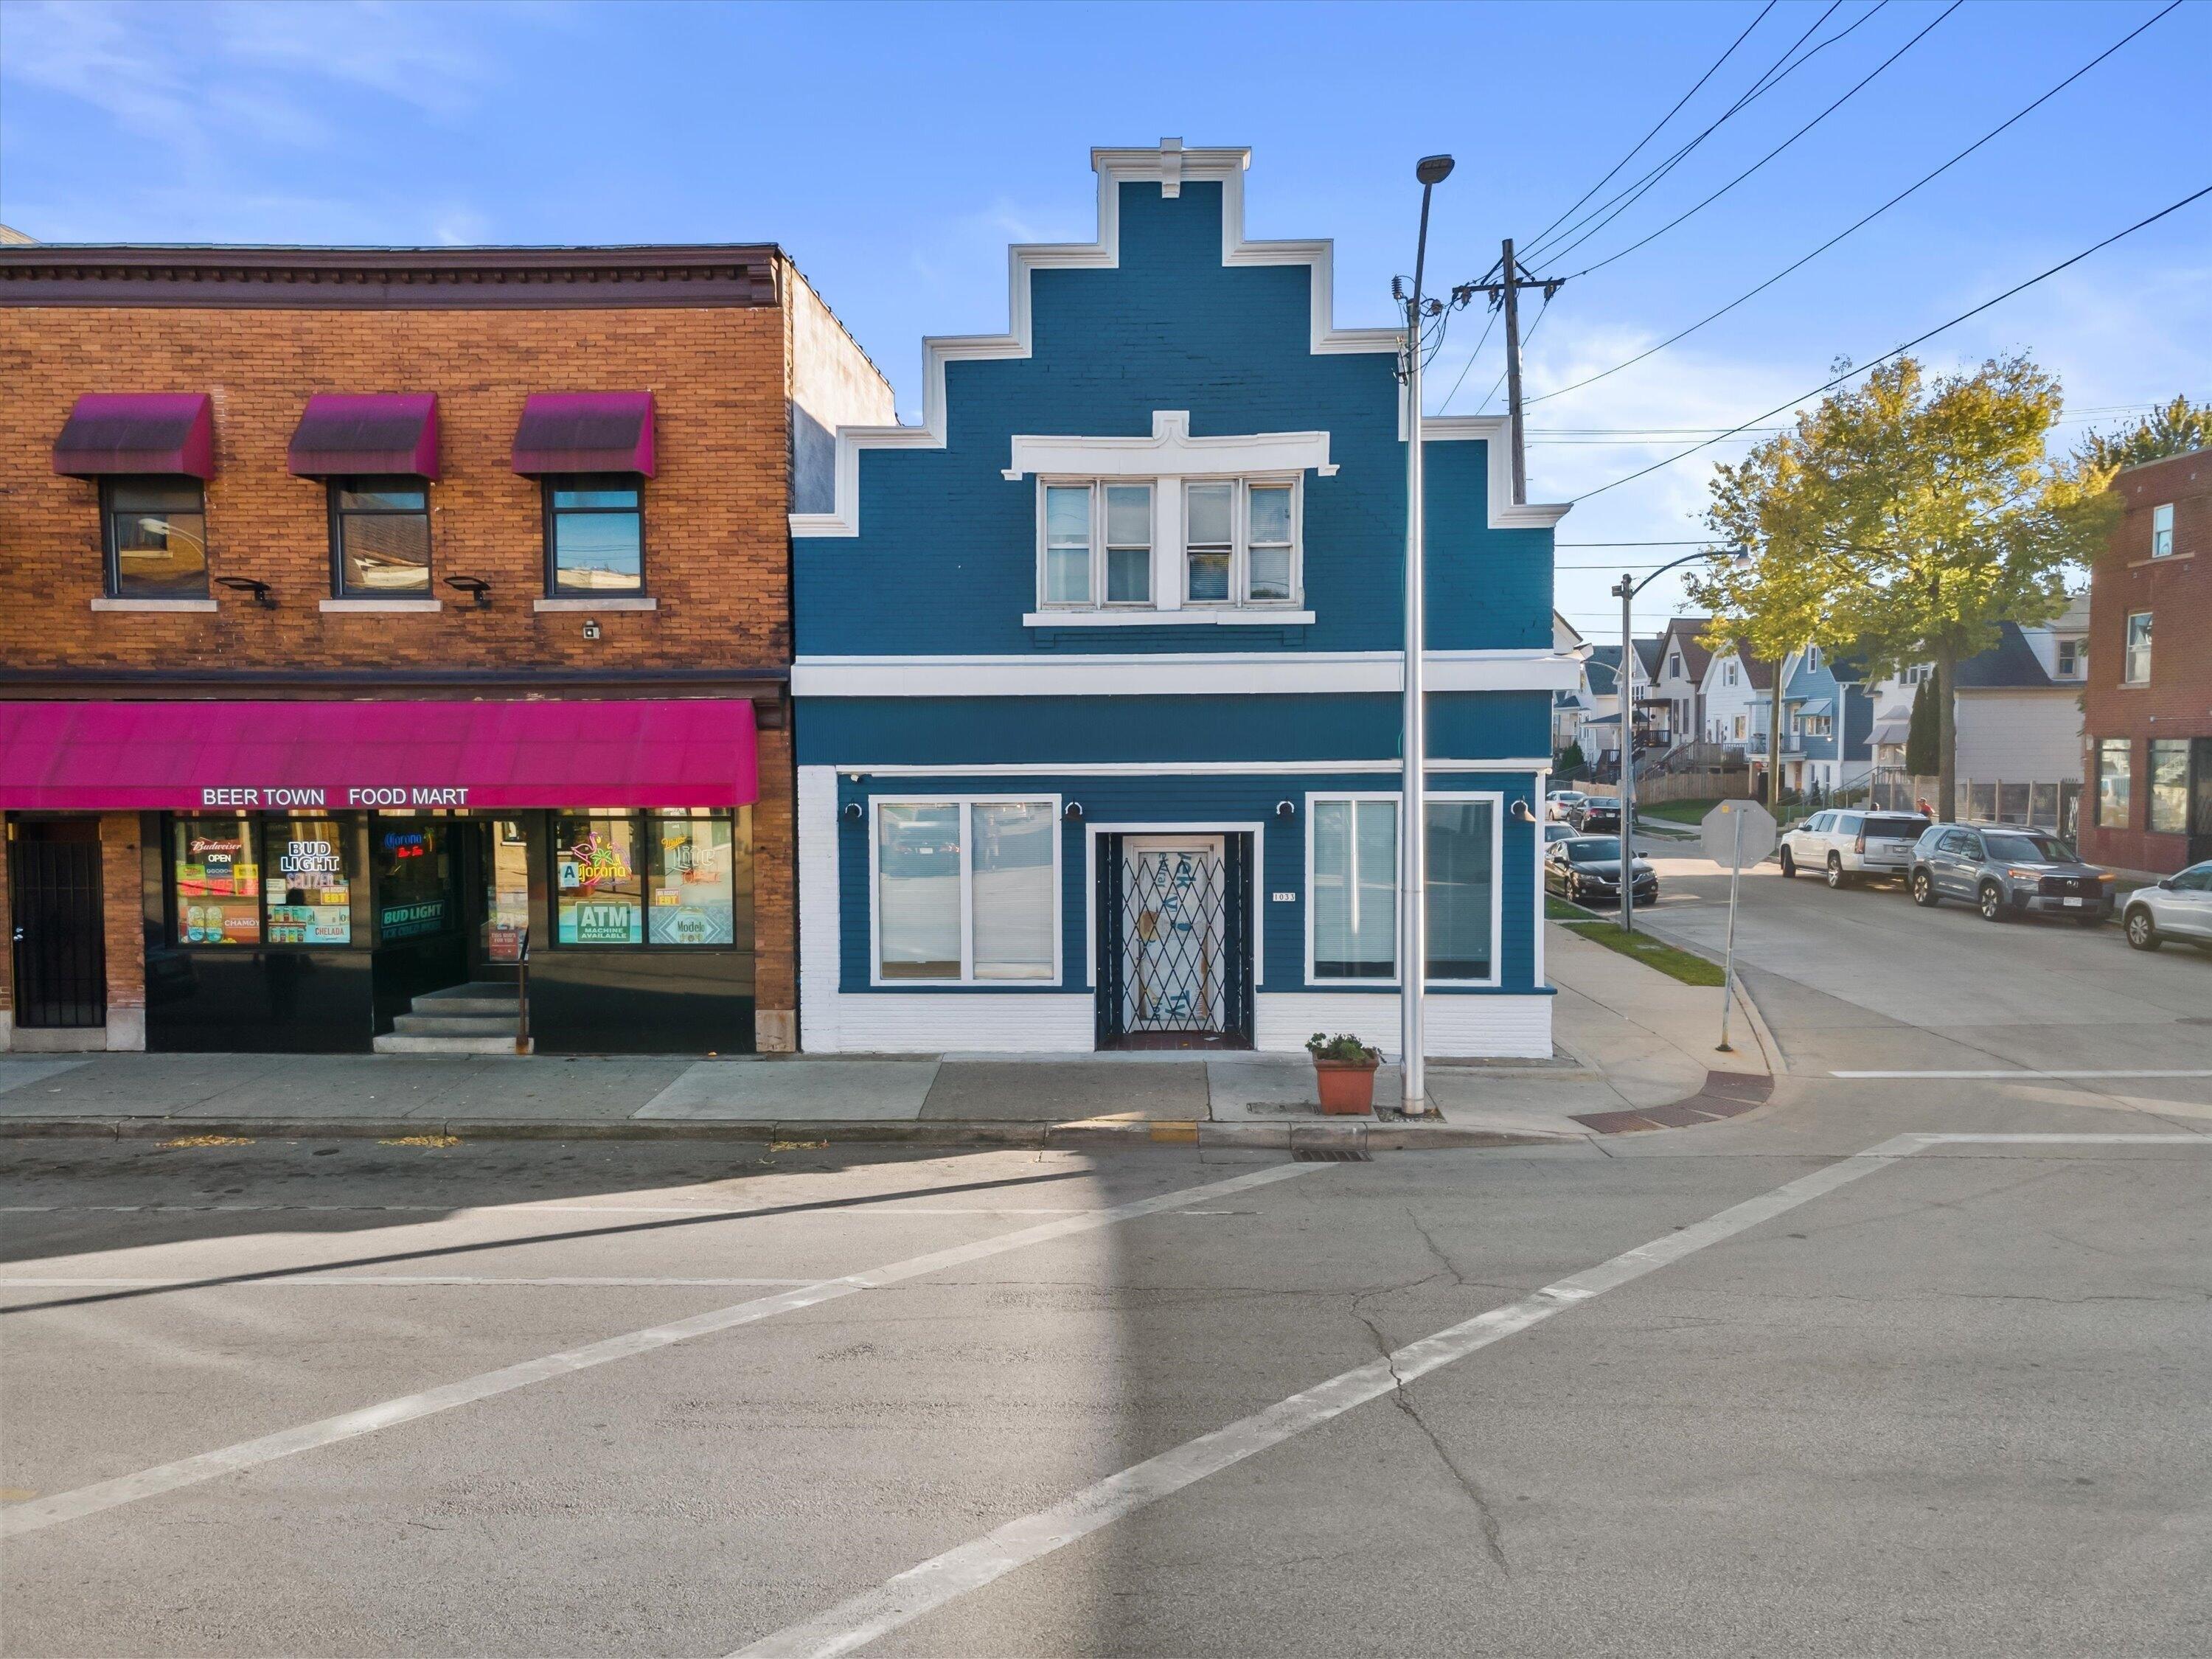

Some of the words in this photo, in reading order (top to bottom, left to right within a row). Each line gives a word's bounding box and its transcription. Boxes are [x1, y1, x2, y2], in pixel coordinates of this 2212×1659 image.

[204, 789, 258, 805] BEER
[263, 789, 324, 805] TOWN
[349, 788, 406, 805] FOOD
[413, 788, 468, 804] MART
[190, 841, 242, 851] Budweiser
[384, 832, 422, 849] Corona
[288, 841, 331, 856] BUD
[208, 855, 232, 863] OPEN
[672, 846, 715, 872] Lite
[564, 866, 575, 879] A
[287, 873, 333, 888] SELTZER
[324, 893, 347, 903] EBT
[659, 896, 678, 905] EBT
[383, 909, 409, 925] BUD
[410, 903, 442, 920] LIGHT
[580, 906, 627, 927] ATM
[315, 928, 344, 936] CHELADA
[677, 920, 705, 933] Modelo
